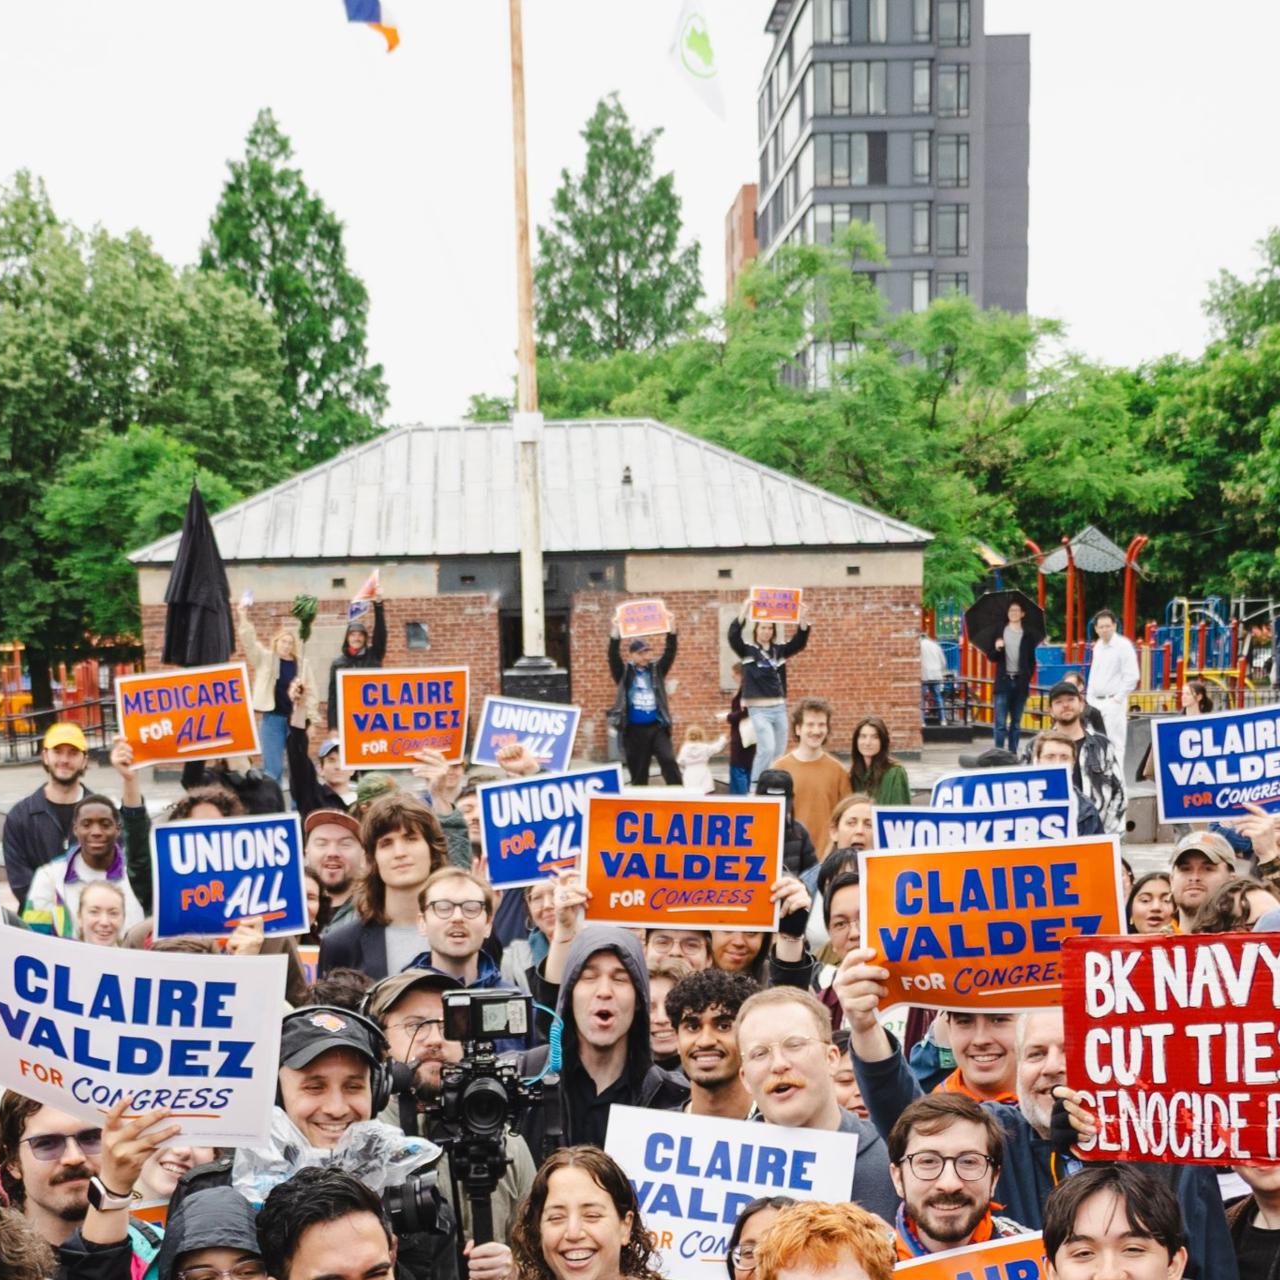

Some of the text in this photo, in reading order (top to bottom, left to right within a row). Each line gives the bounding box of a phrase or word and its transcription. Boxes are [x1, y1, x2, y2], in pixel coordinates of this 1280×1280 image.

[123, 678, 245, 716] MEDICARE
[361, 679, 454, 708] CLAIRE
[139, 711, 233, 743] FOR ALL
[352, 708, 462, 732] VALDEZ
[491, 705, 568, 736] UNIONS
[361, 739, 388, 756] FOR
[935, 779, 1048, 807] CLAIRE
[1183, 791, 1213, 808] FOR
[500, 821, 581, 864] FOR AL
[615, 811, 755, 846] CLAIRE
[882, 814, 1066, 849] WORKERS
[169, 826, 290, 875] UNIONS
[600, 851, 767, 882] VALDEZ
[181, 871, 287, 919] FOR ALL
[609, 890, 646, 908] FOR
[895, 862, 1080, 916] CLAIRE
[14, 954, 237, 1029] CLAIRE
[900, 961, 1063, 995] FOR CONGRE
[1084, 950, 1147, 1018] BK
[1084, 1023, 1177, 1086] CUT
[20, 1058, 63, 1089] FOR
[1076, 1089, 1252, 1160] GENOCIDE
[643, 1132, 817, 1191] CLAIRE
[647, 1231, 674, 1250] OR
